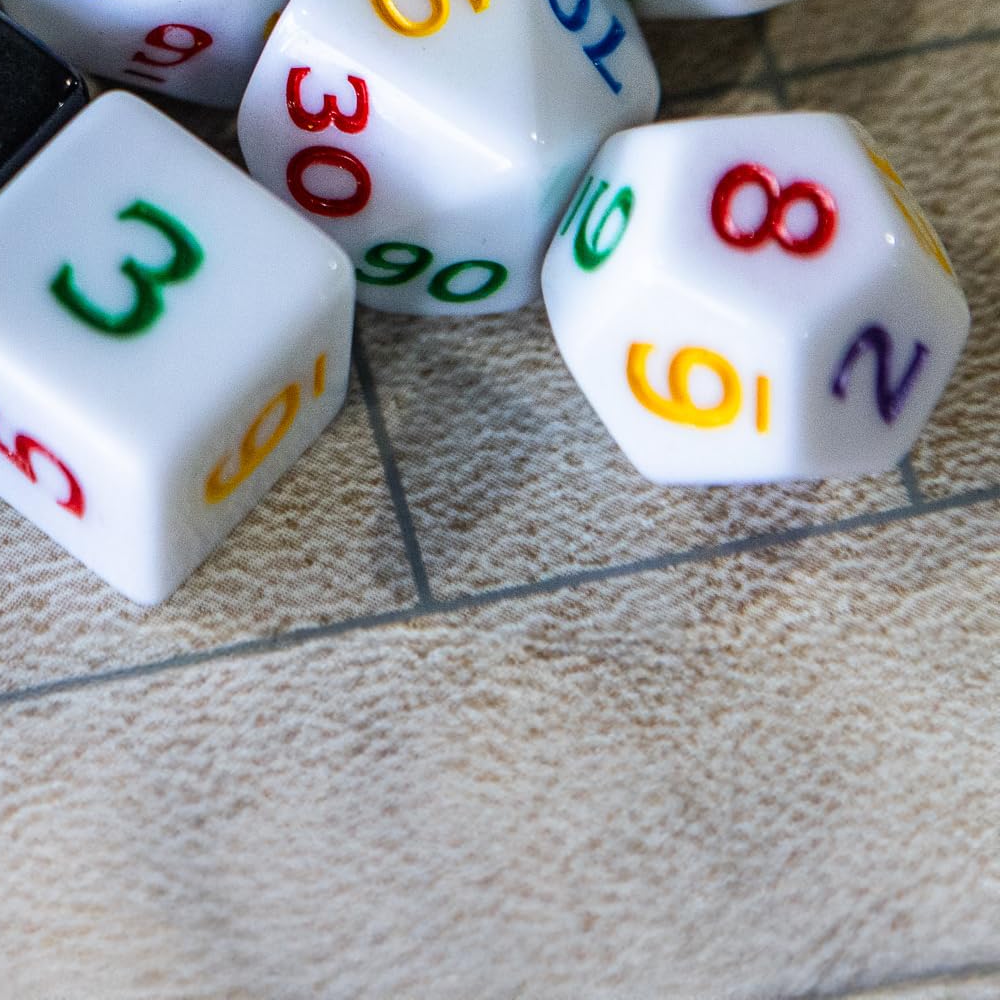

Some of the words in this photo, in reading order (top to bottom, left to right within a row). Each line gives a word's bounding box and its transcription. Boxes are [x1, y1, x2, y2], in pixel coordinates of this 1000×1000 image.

[286, 66, 371, 217] 30
[711, 162, 838, 259] 8
[50, 198, 205, 340] 3
[355, 241, 508, 303] 90
[831, 322, 930, 425] 2
